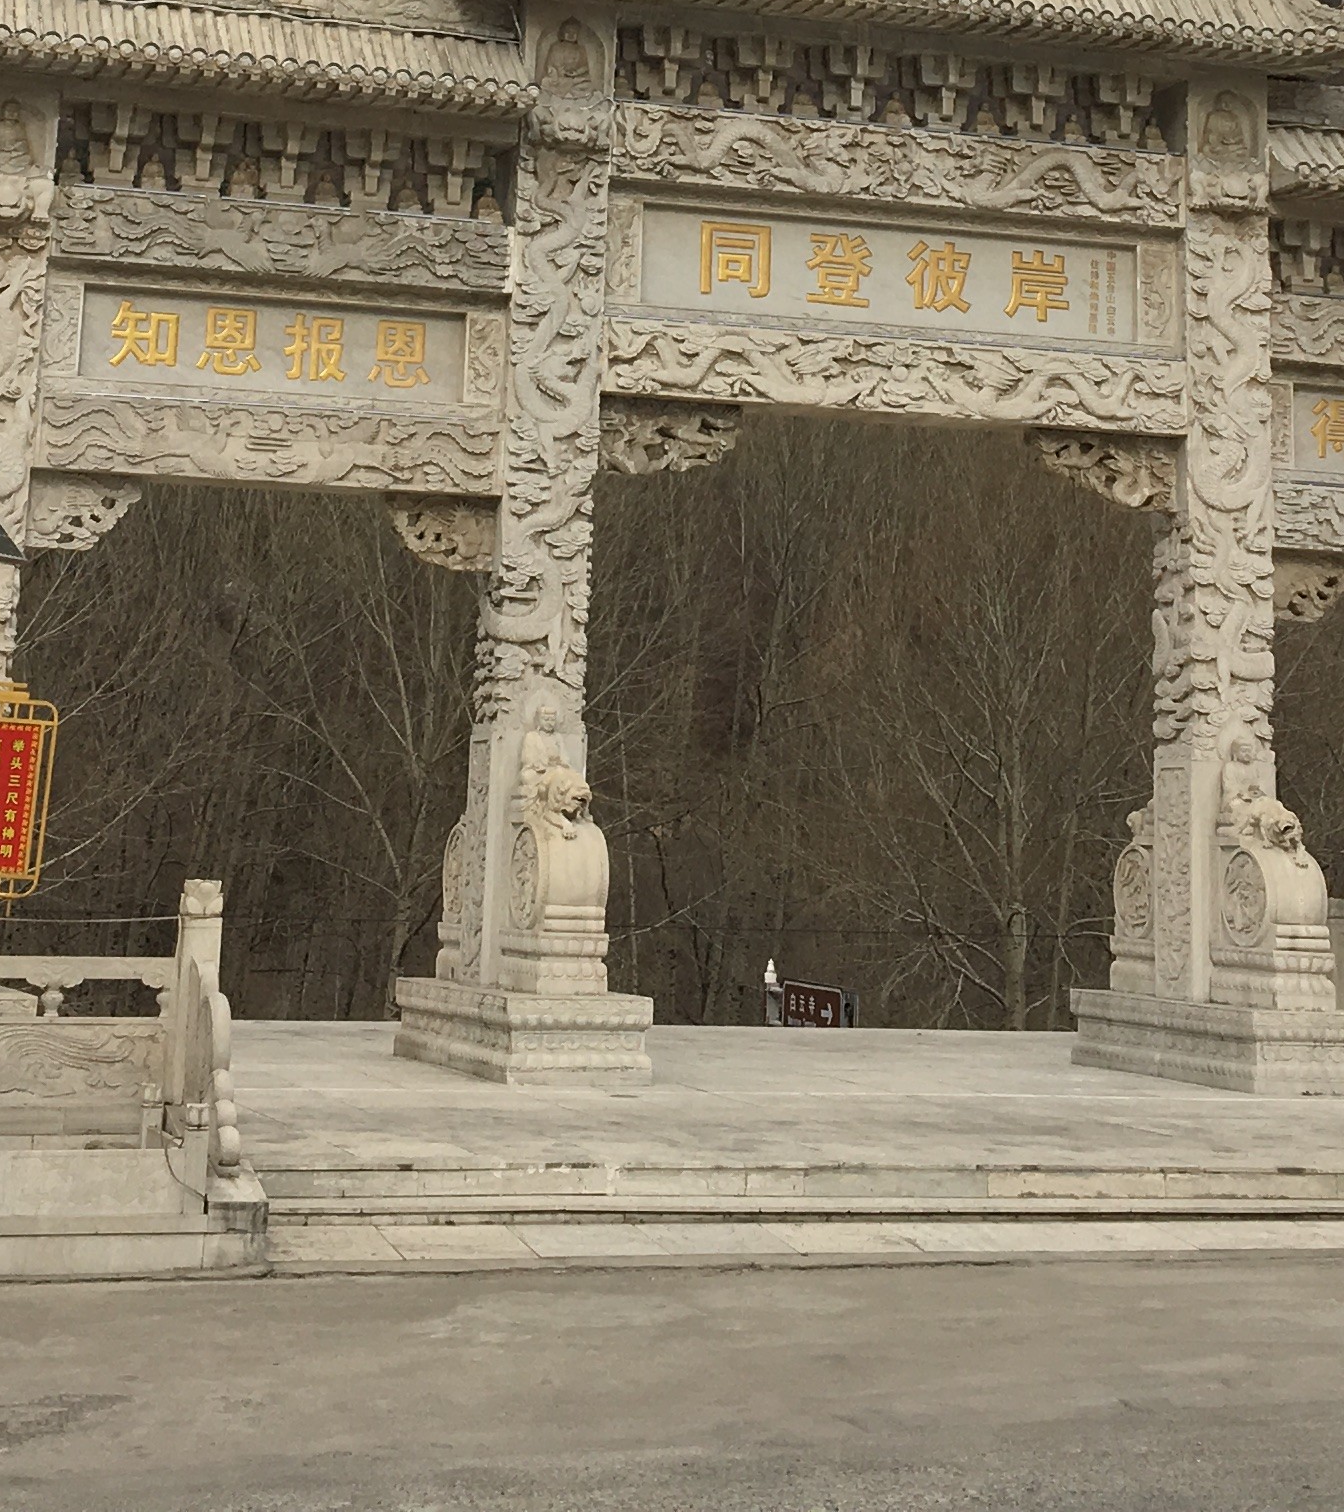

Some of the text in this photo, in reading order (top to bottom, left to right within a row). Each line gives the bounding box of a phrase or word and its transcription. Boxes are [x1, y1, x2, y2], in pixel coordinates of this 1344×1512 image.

[699, 219, 1070, 324] 同登彼岸
[109, 299, 431, 389] 知恩报恩
[0, 738, 25, 858] 举头三尺有神明
